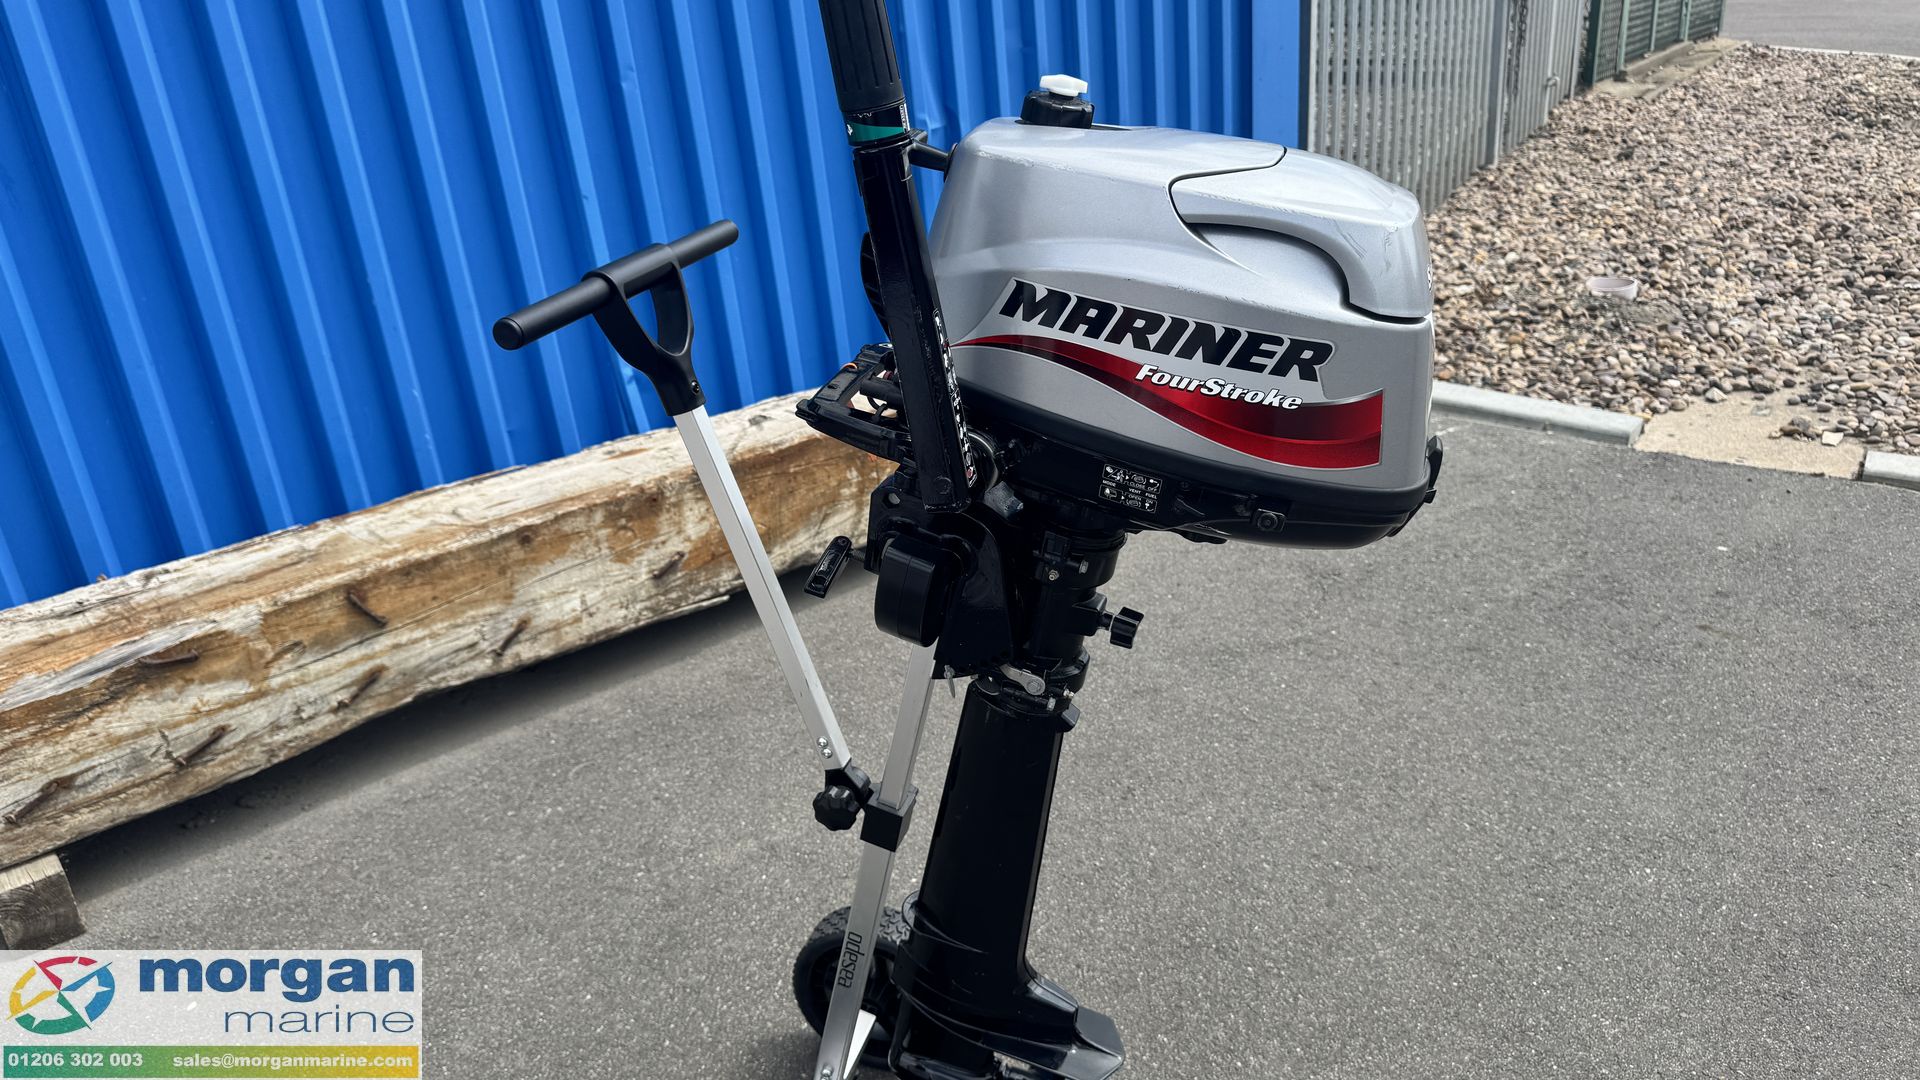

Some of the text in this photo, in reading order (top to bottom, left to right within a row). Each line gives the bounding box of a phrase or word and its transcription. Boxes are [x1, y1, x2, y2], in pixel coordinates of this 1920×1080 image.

[999, 279, 1333, 382] MARINER
[1135, 364, 1303, 411] FourStroke
[839, 932, 865, 988] odesea
